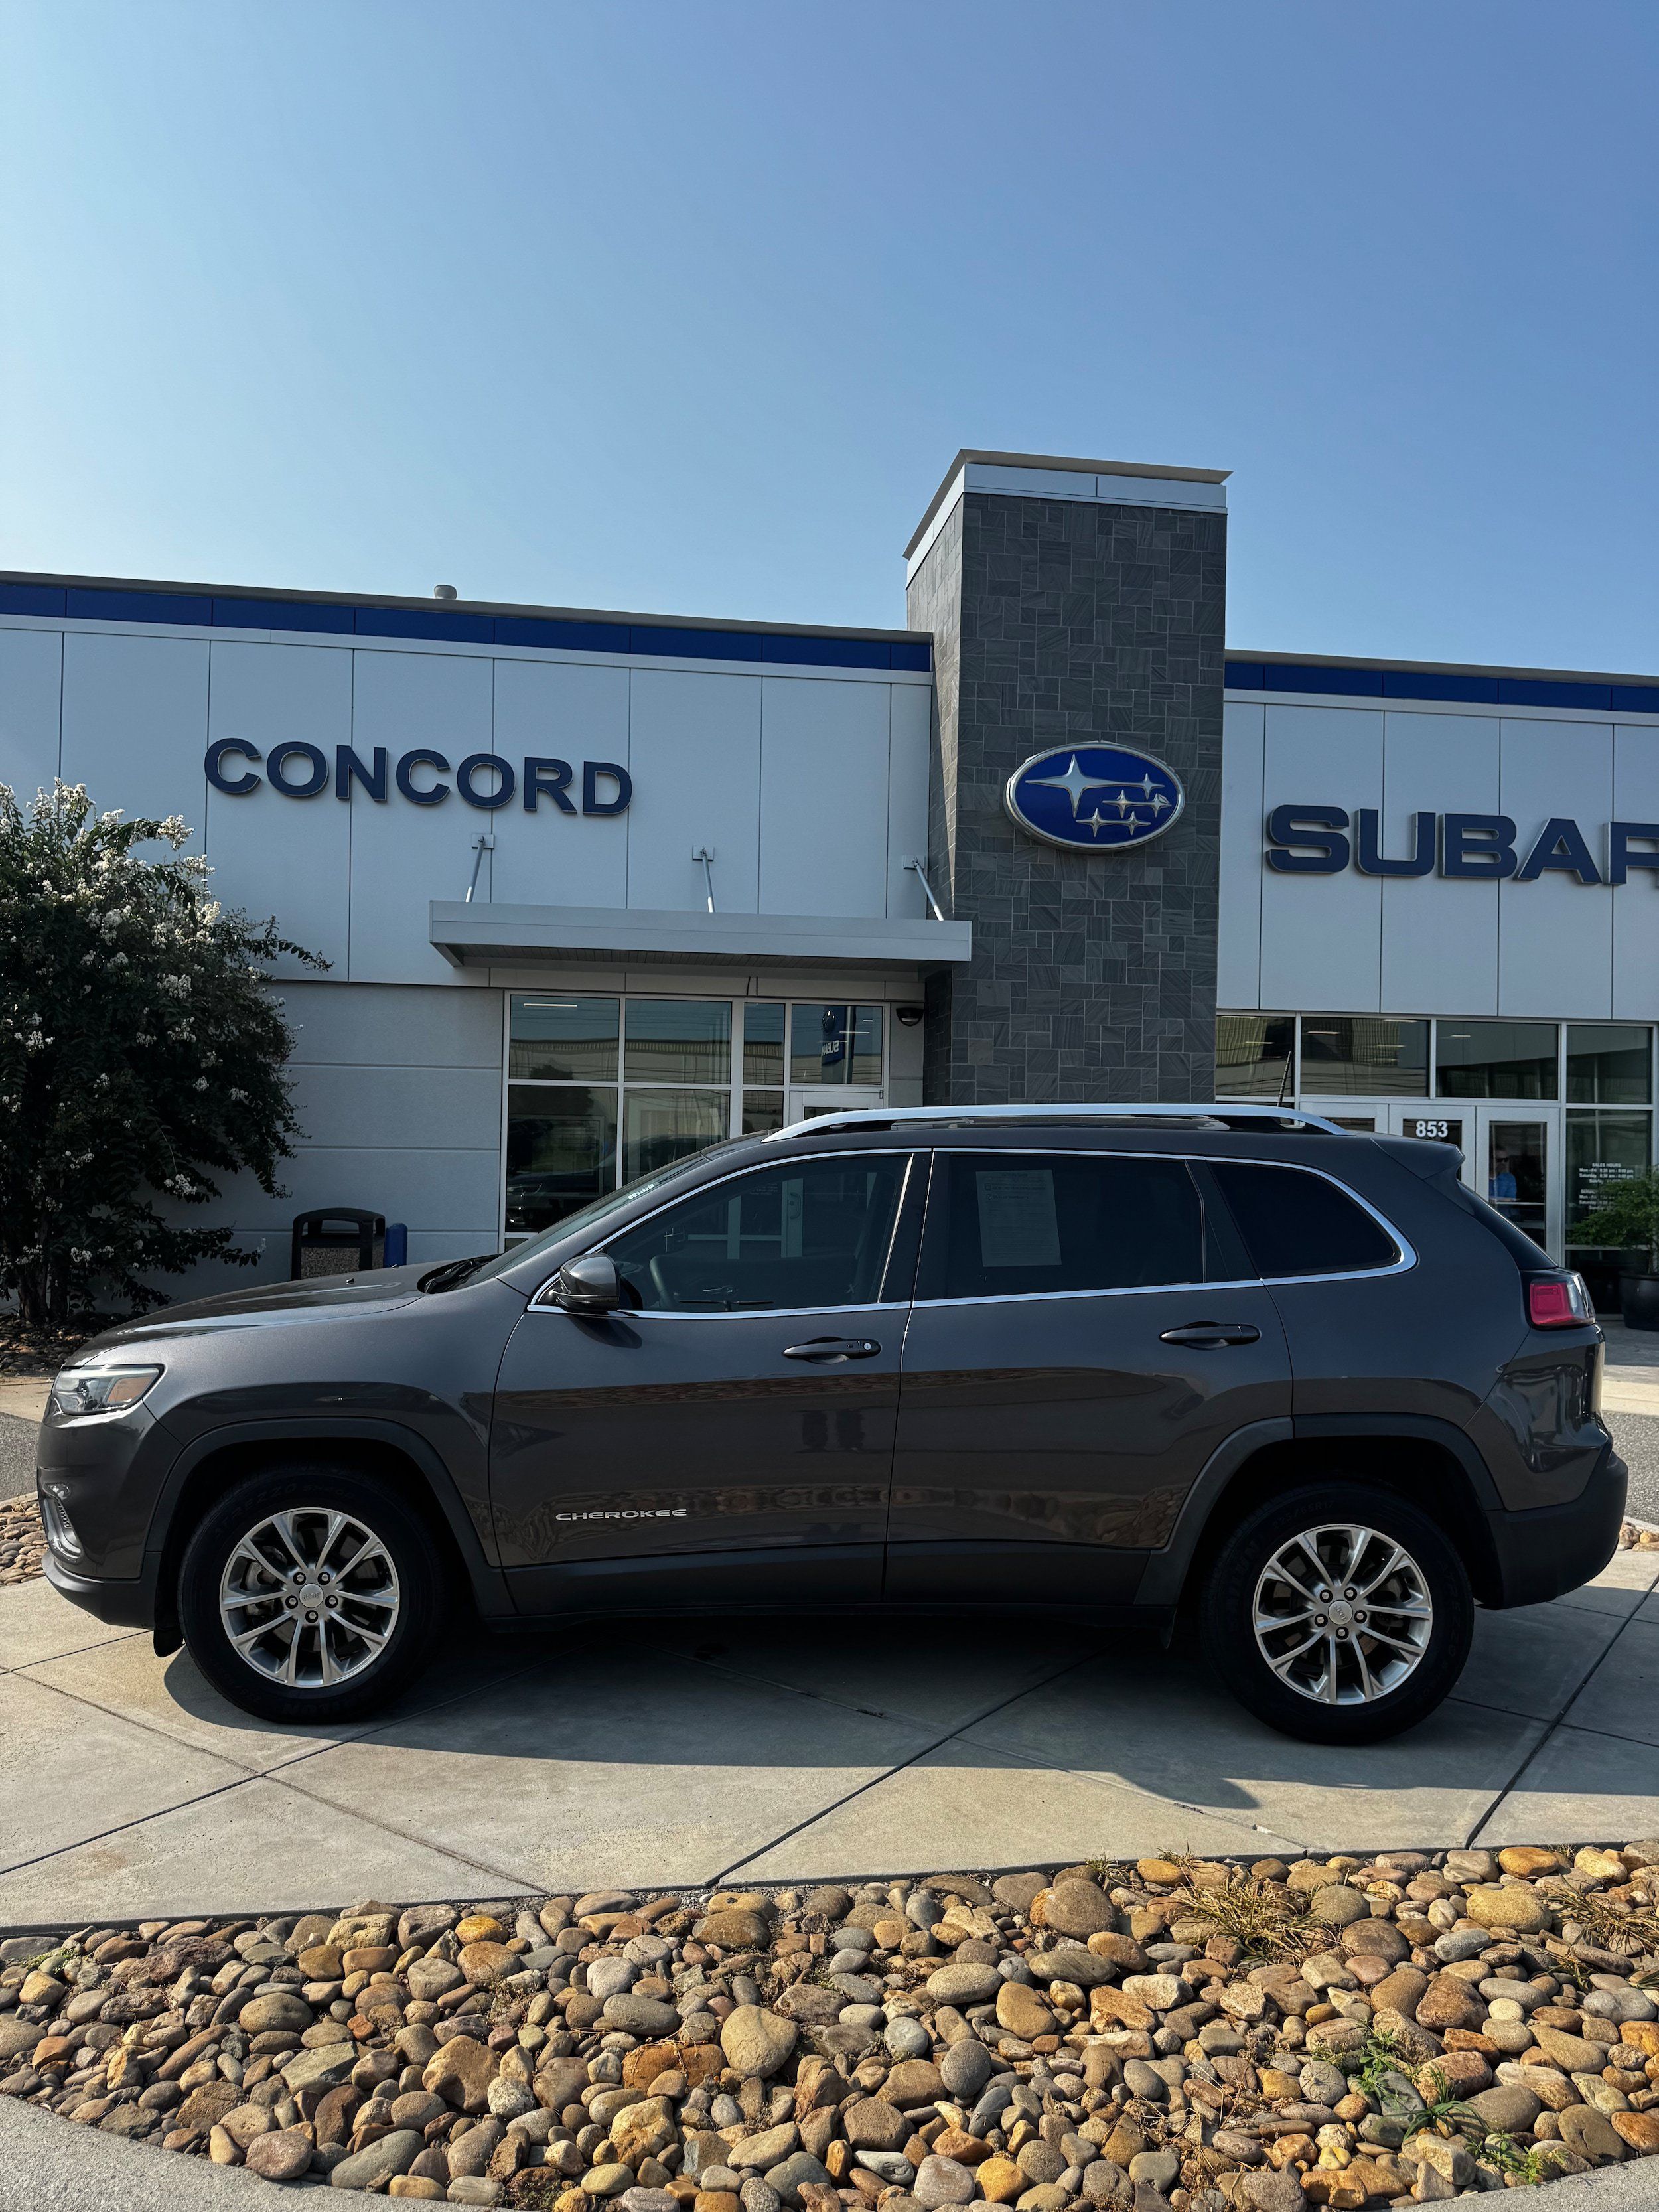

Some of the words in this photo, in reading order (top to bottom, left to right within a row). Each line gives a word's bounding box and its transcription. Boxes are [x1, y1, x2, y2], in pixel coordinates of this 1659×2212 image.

[204, 738, 632, 814] CONCORD
[1267, 804, 1659, 886] SUBAR
[1416, 1120, 1448, 1137] 853
[555, 1509, 687, 1520] CHEROKEE
